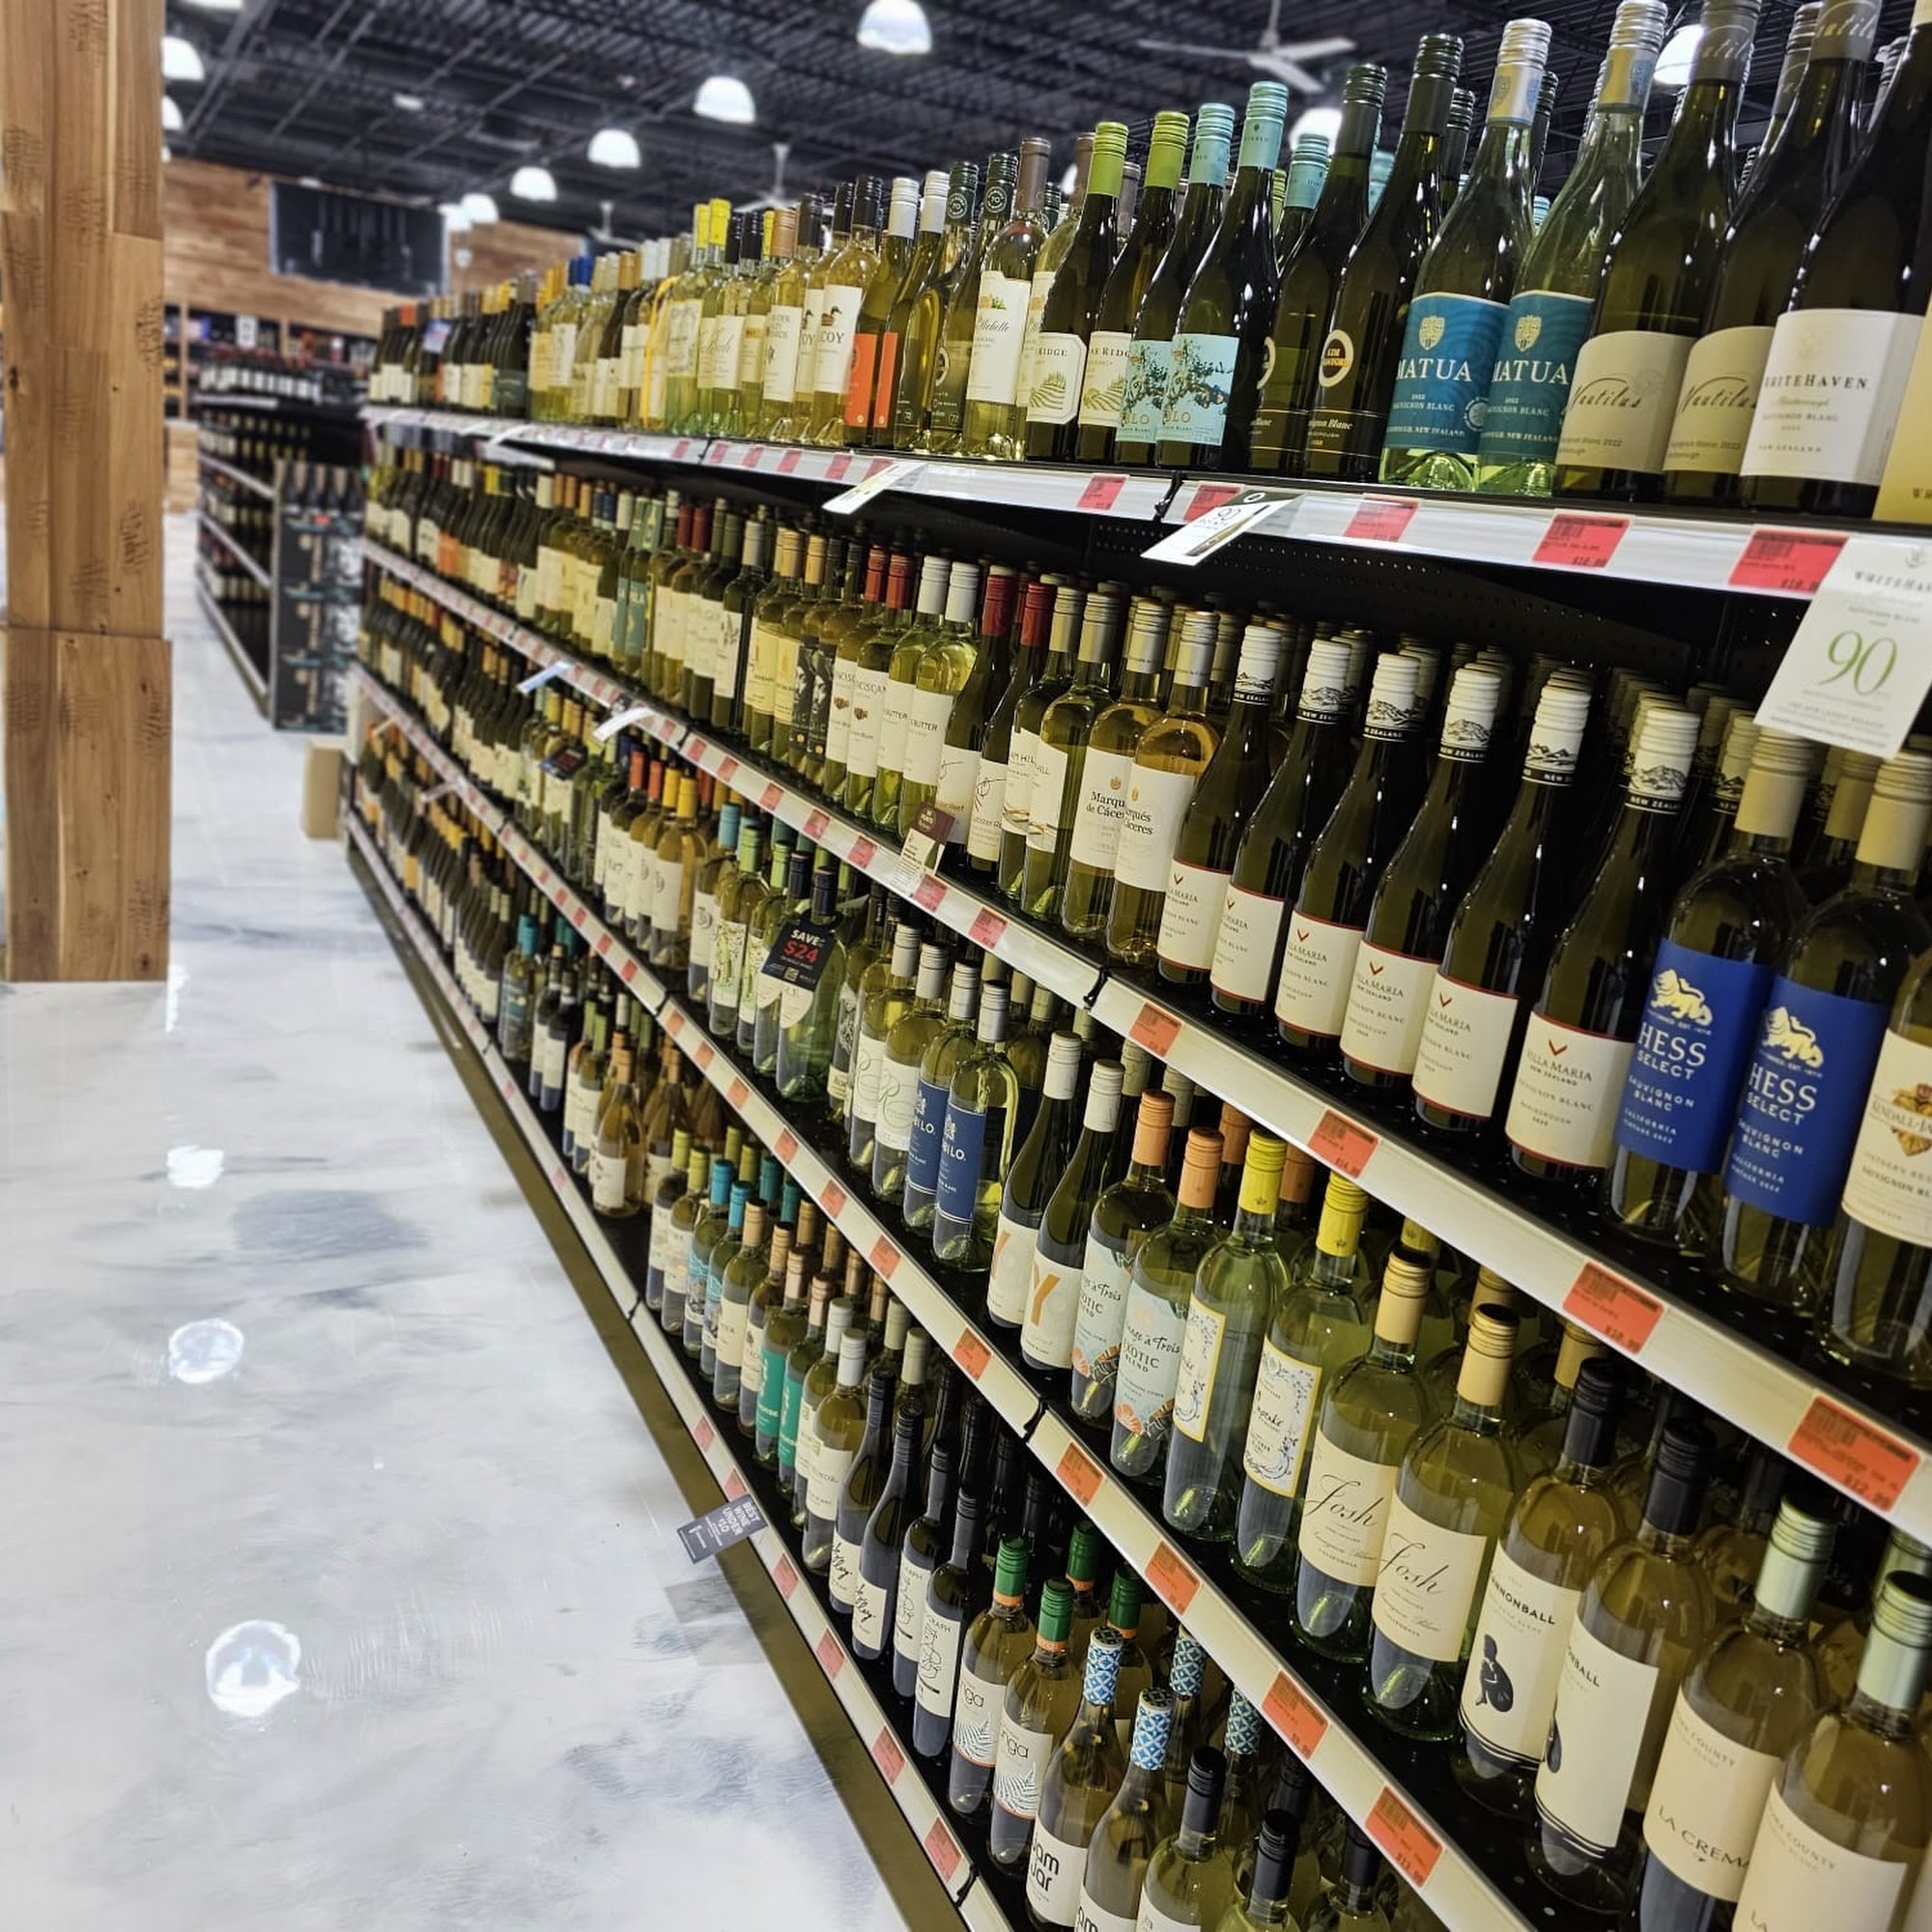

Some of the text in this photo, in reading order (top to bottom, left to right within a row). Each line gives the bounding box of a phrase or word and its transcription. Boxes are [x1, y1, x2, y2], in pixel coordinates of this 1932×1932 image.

[1818, 629, 1898, 696] 90
[1085, 803, 1096, 813] de
[790, 929, 820, 948] SAVE
[1370, 979, 1405, 999] MARIA
[1439, 1012, 1472, 1033] MARIA
[1637, 1022, 1707, 1067] HESS
[1549, 1061, 1594, 1083] MARIA
[1637, 1050, 1695, 1081] SELECT
[1628, 1074, 1695, 1108] SAUVIGNON
[1634, 1090, 1673, 1112] BLANC
[1747, 1063, 1818, 1112] HESS
[1557, 1093, 1595, 1113] BLANC
[1747, 1092, 1805, 1125] SELECT
[1742, 1134, 1781, 1159] BLANC
[1152, 1336, 1181, 1354] Trois
[1304, 1474, 1384, 1527] Josh
[1378, 1532, 1449, 1596] Josh
[1690, 1731, 1736, 1768] COUNTY
[1659, 1804, 1677, 1833] LA
[1787, 1833, 1836, 1872] COUNTY
